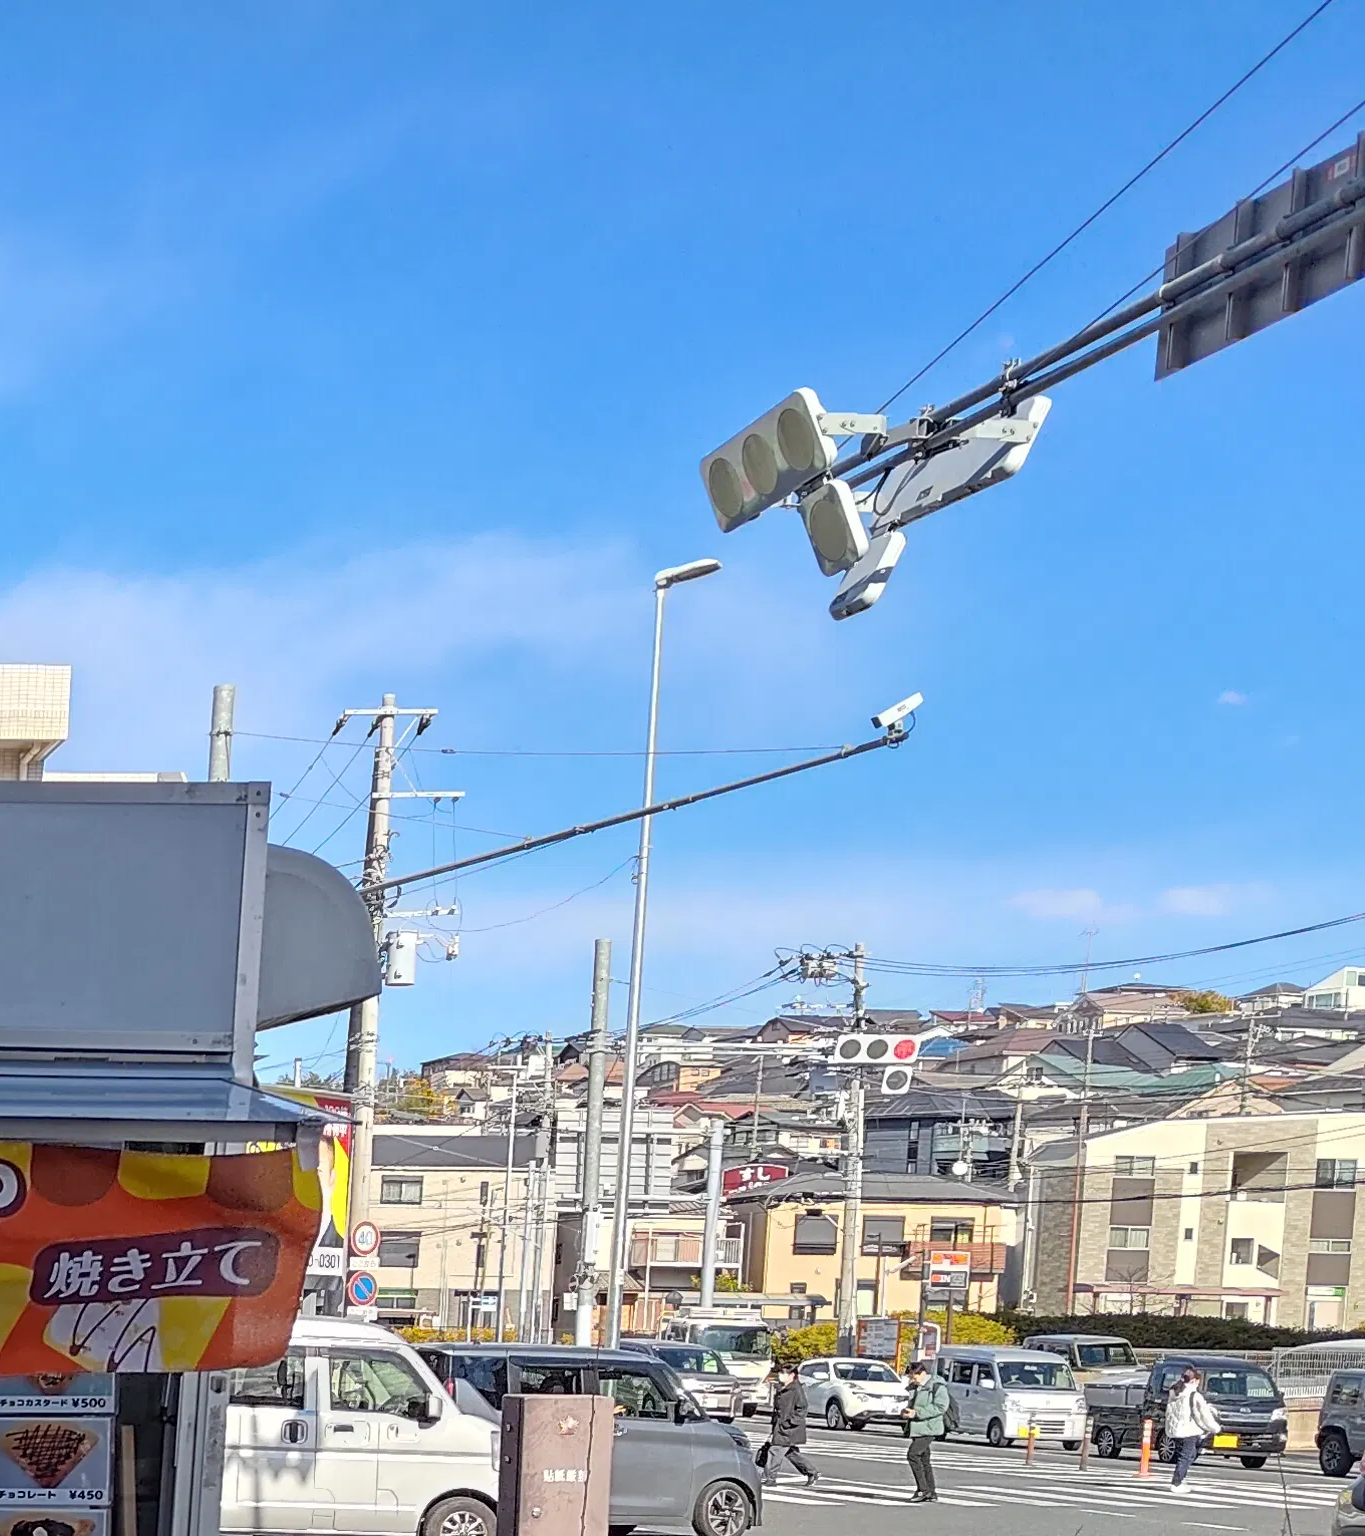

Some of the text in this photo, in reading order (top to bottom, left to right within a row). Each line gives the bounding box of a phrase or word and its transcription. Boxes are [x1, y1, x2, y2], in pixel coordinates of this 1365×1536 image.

[739, 1166, 771, 1181] すし
[45, 1238, 265, 1300] 焼き立て
[0, 1398, 106, 1409] チョコカスタード ¥500
[69, 1490, 104, 1501] ¥450
